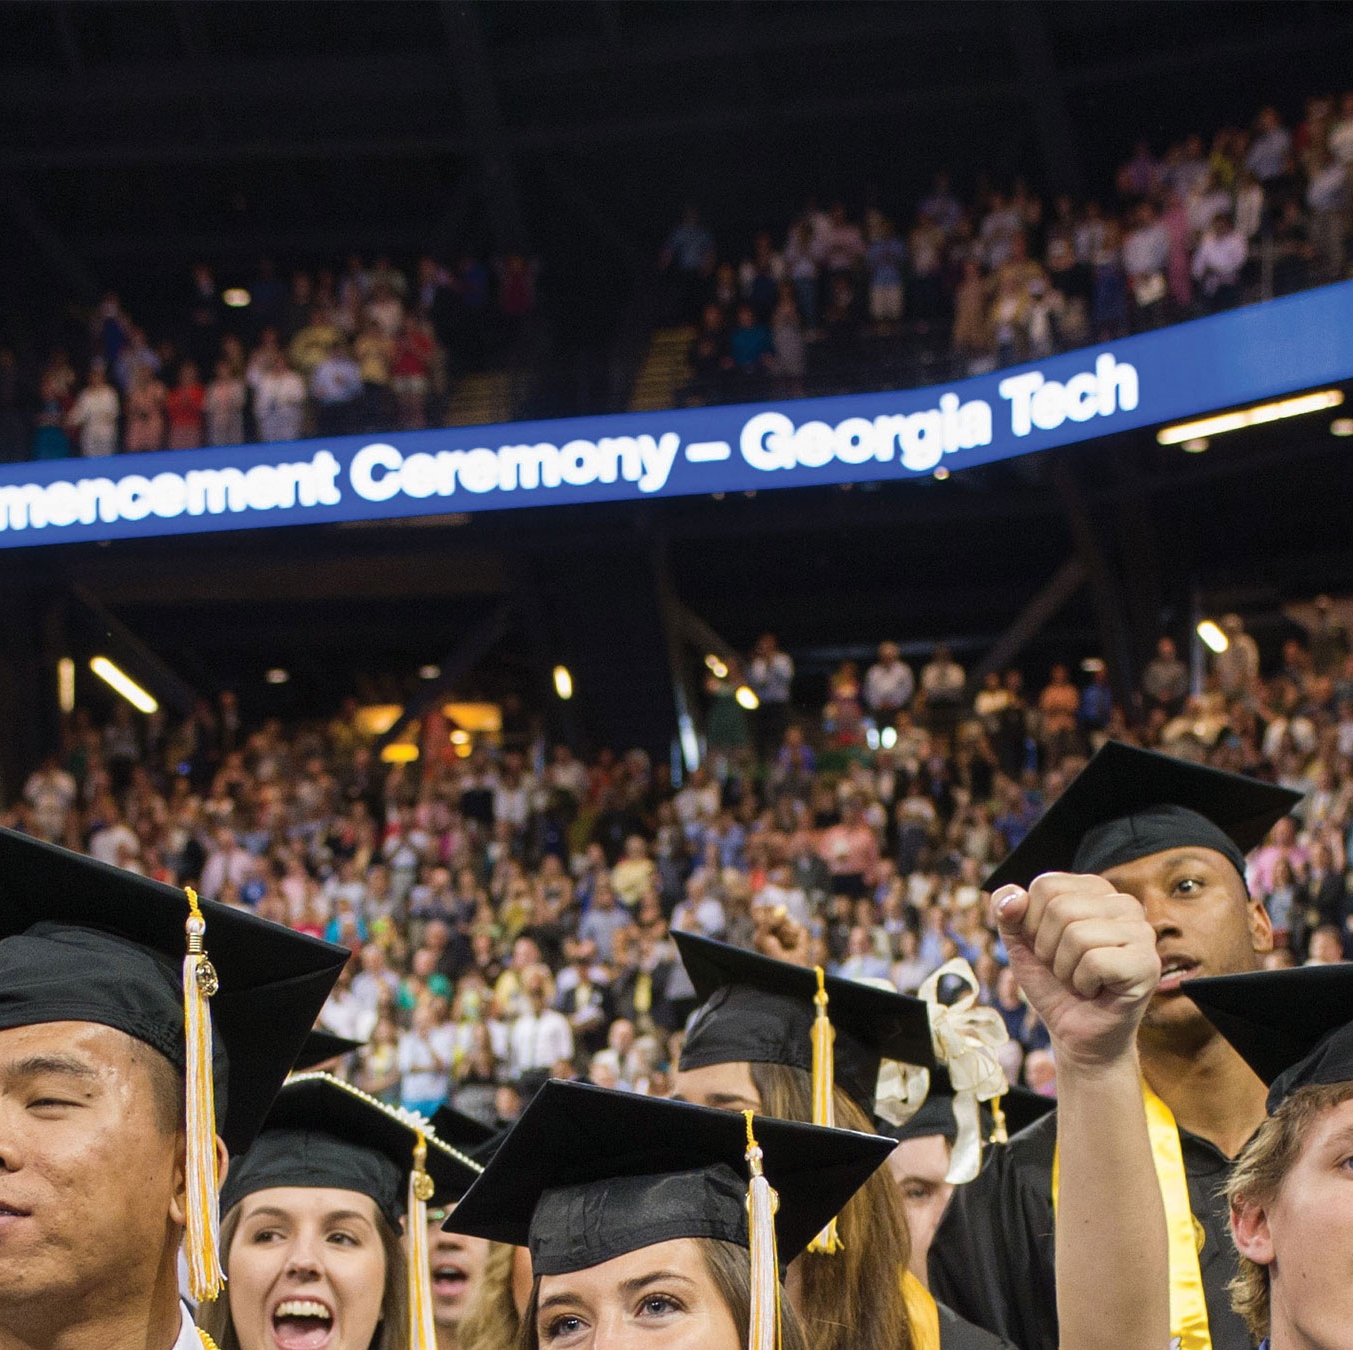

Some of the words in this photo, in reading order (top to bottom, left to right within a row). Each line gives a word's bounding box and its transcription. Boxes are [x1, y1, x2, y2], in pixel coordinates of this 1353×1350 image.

[349, 431, 681, 502] Ceremony
[740, 392, 993, 481] Georgia
[999, 352, 1140, 438] Tech
